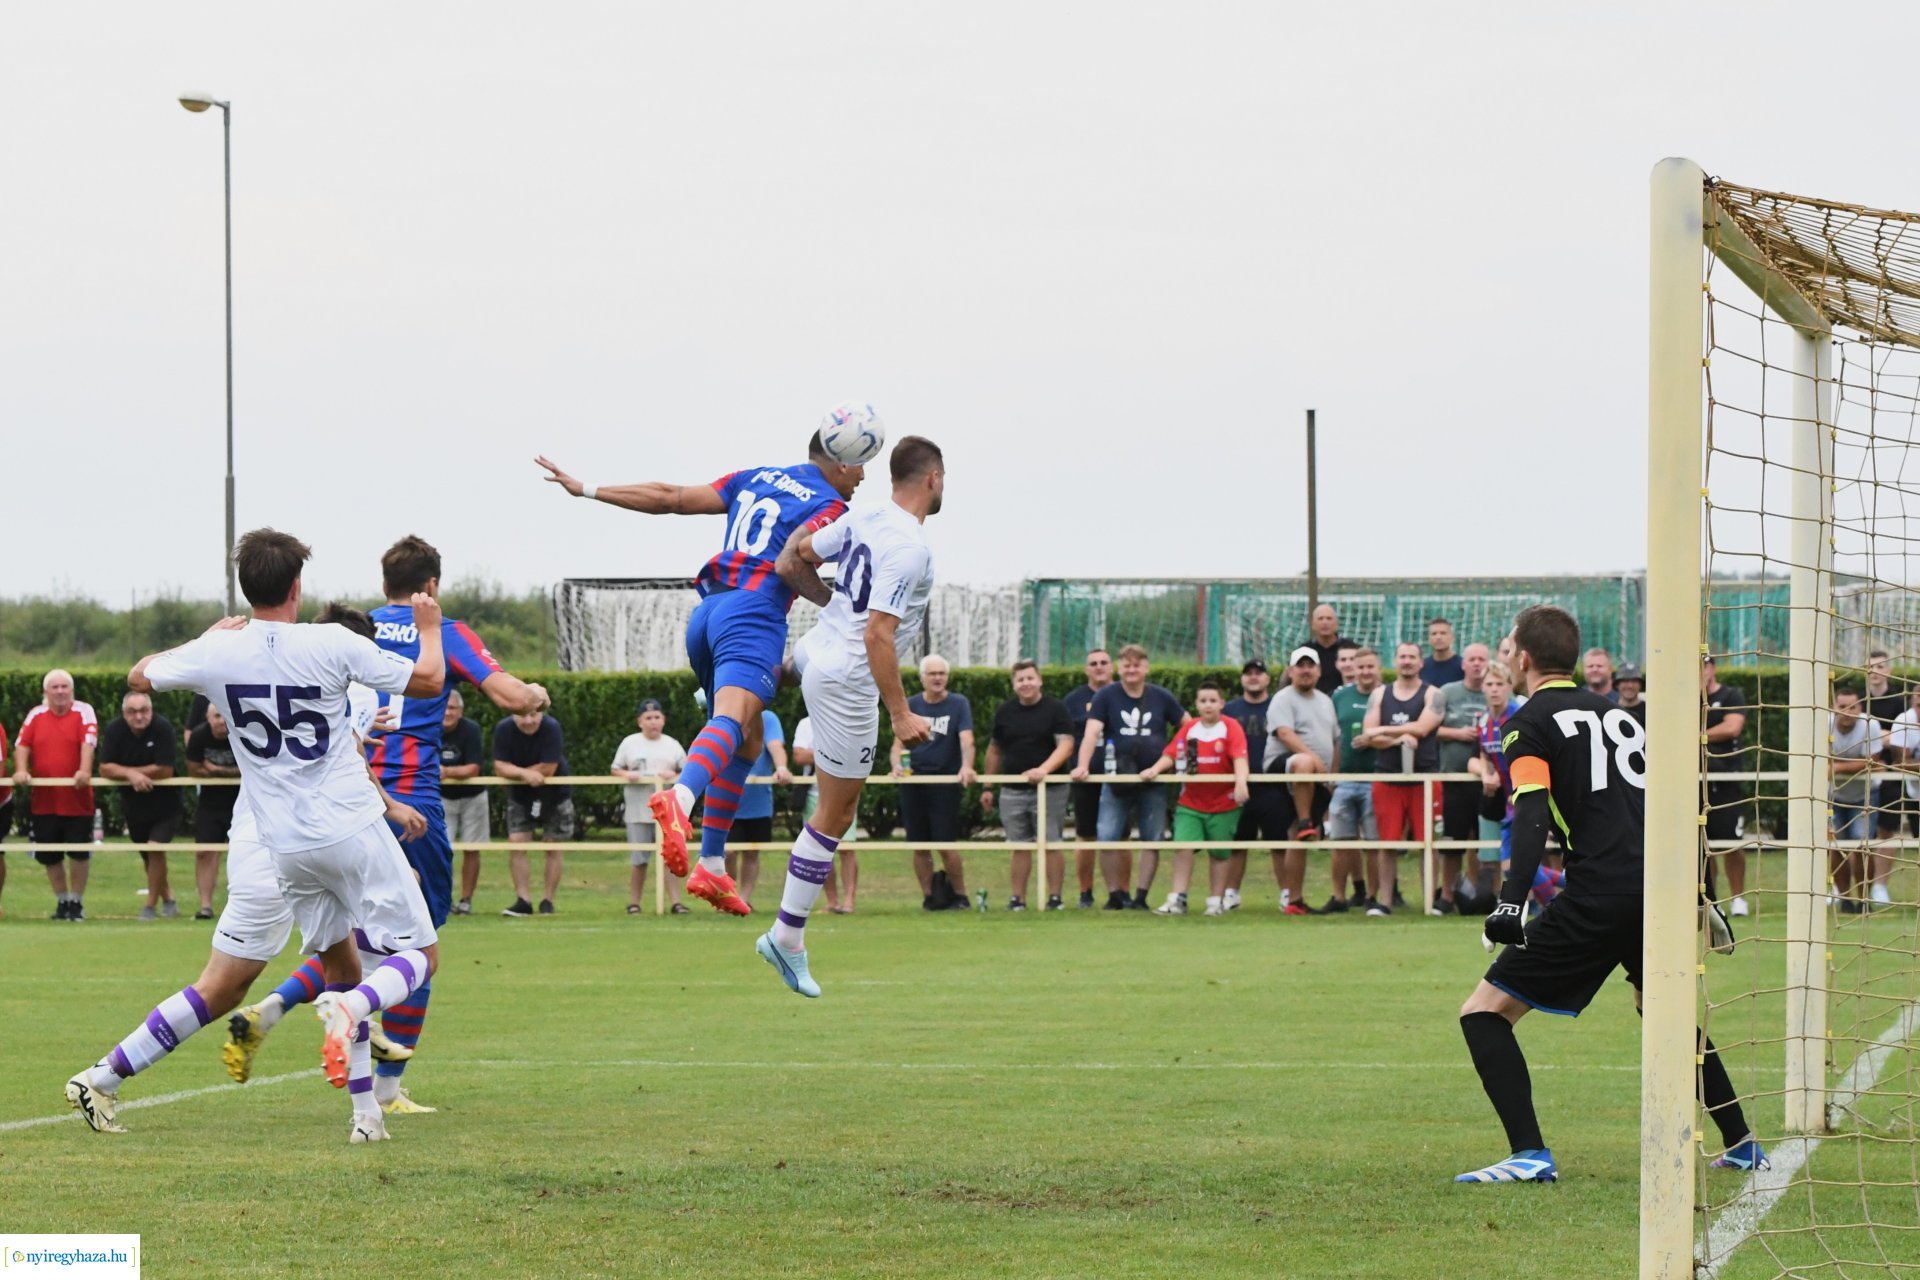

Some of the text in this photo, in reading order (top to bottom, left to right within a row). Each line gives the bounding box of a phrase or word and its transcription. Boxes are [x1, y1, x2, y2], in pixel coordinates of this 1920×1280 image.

[726, 489, 781, 556] 10
[225, 684, 330, 761] 55
[1552, 708, 1646, 792] 78
